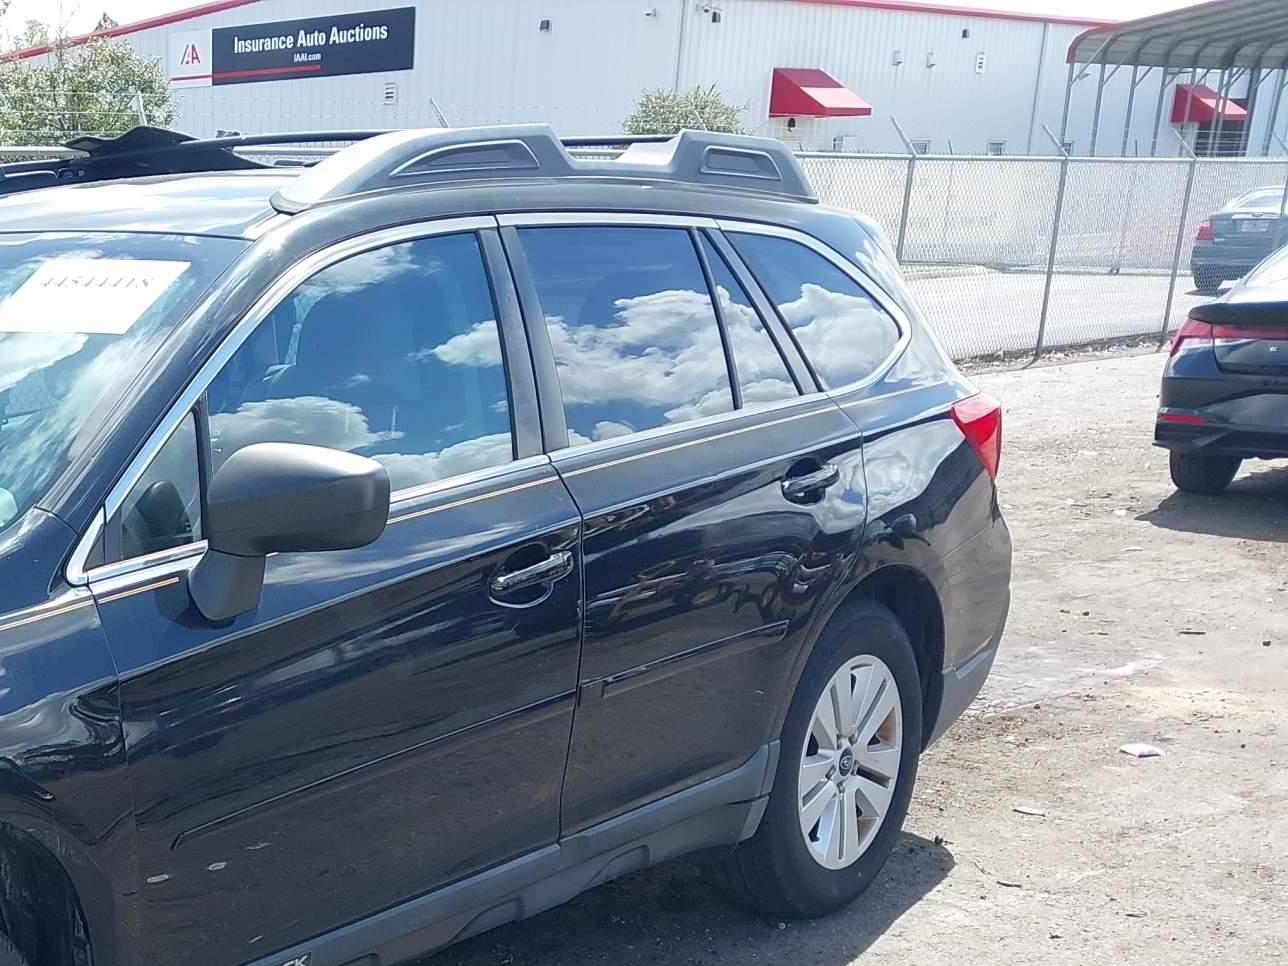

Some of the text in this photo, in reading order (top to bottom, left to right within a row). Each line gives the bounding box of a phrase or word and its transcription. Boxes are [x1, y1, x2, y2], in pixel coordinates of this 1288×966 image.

[234, 23, 389, 54] Insurance Auto Auctions
